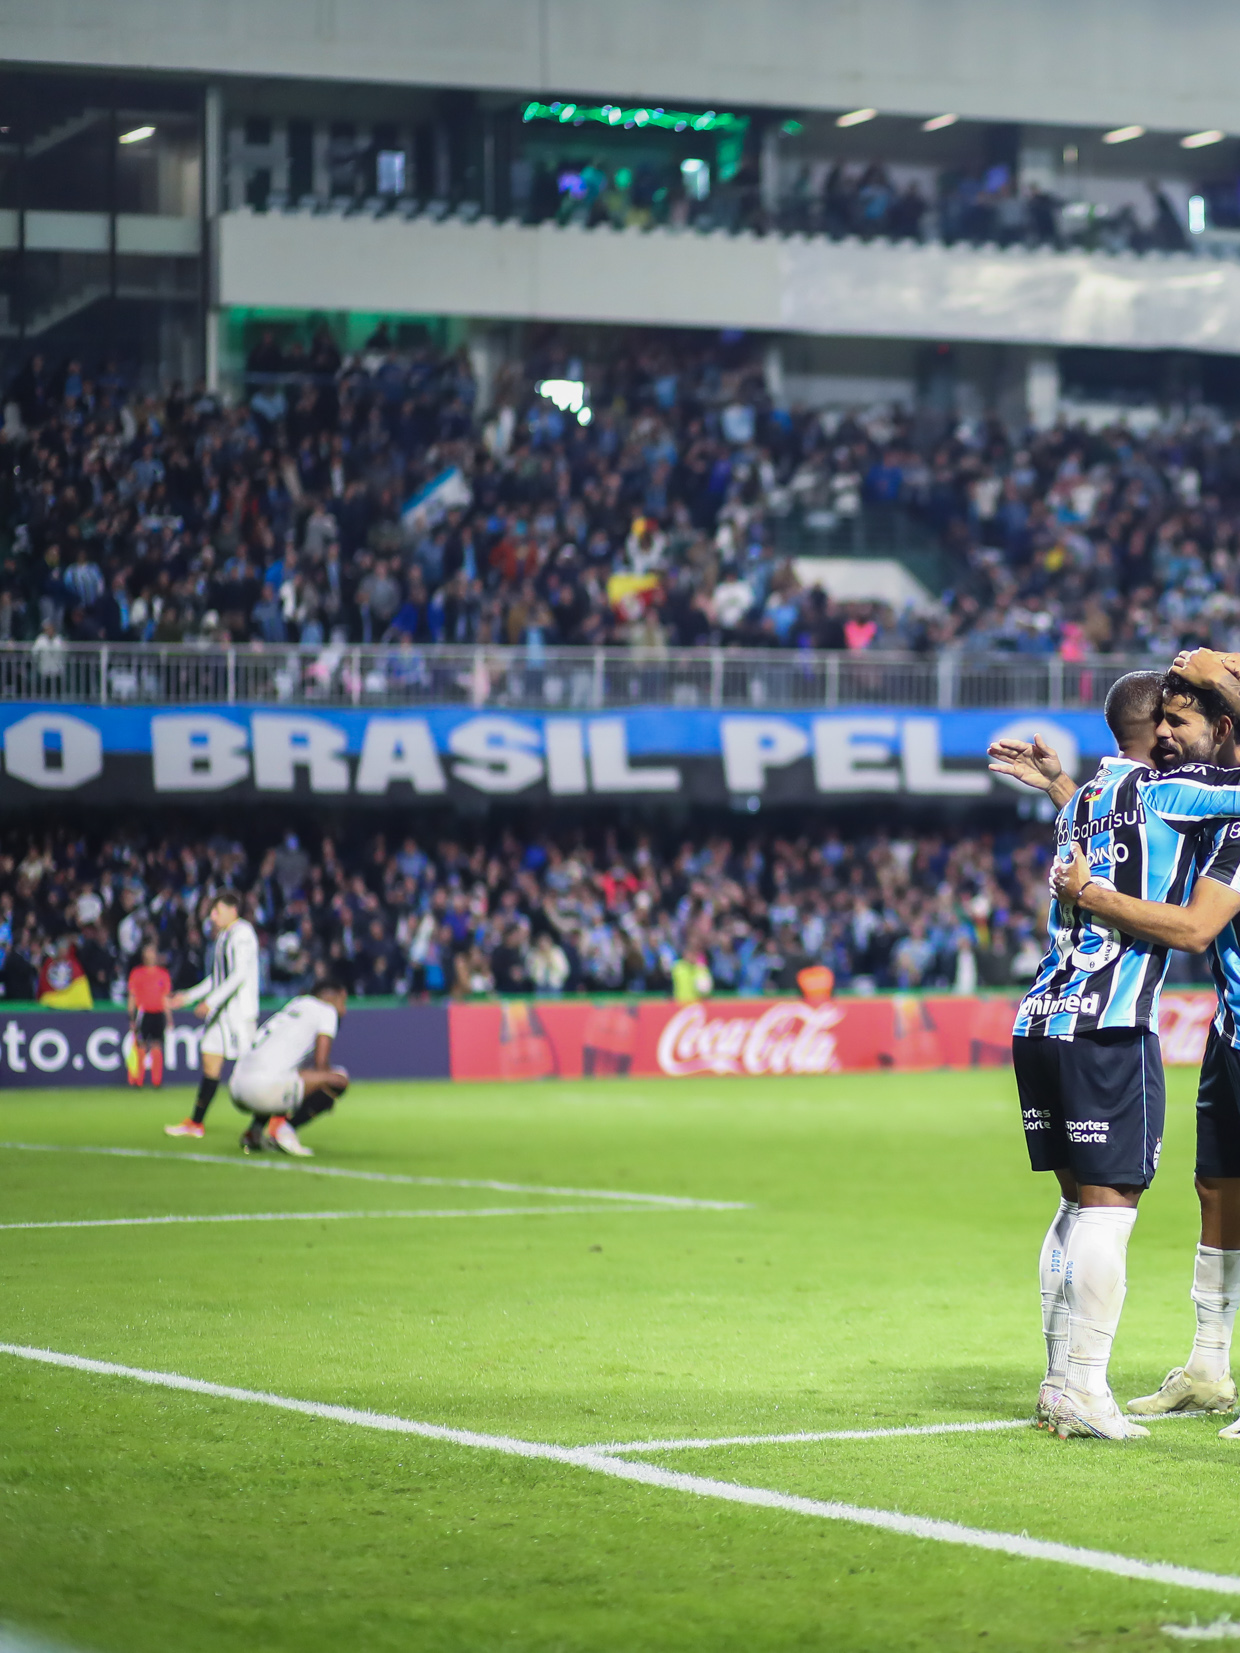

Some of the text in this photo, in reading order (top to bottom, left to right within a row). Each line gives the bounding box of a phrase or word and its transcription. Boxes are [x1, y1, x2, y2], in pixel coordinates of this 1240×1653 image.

[3, 712, 103, 791] O
[152, 712, 681, 795] BRASIL
[1071, 803, 1146, 841] banrisul
